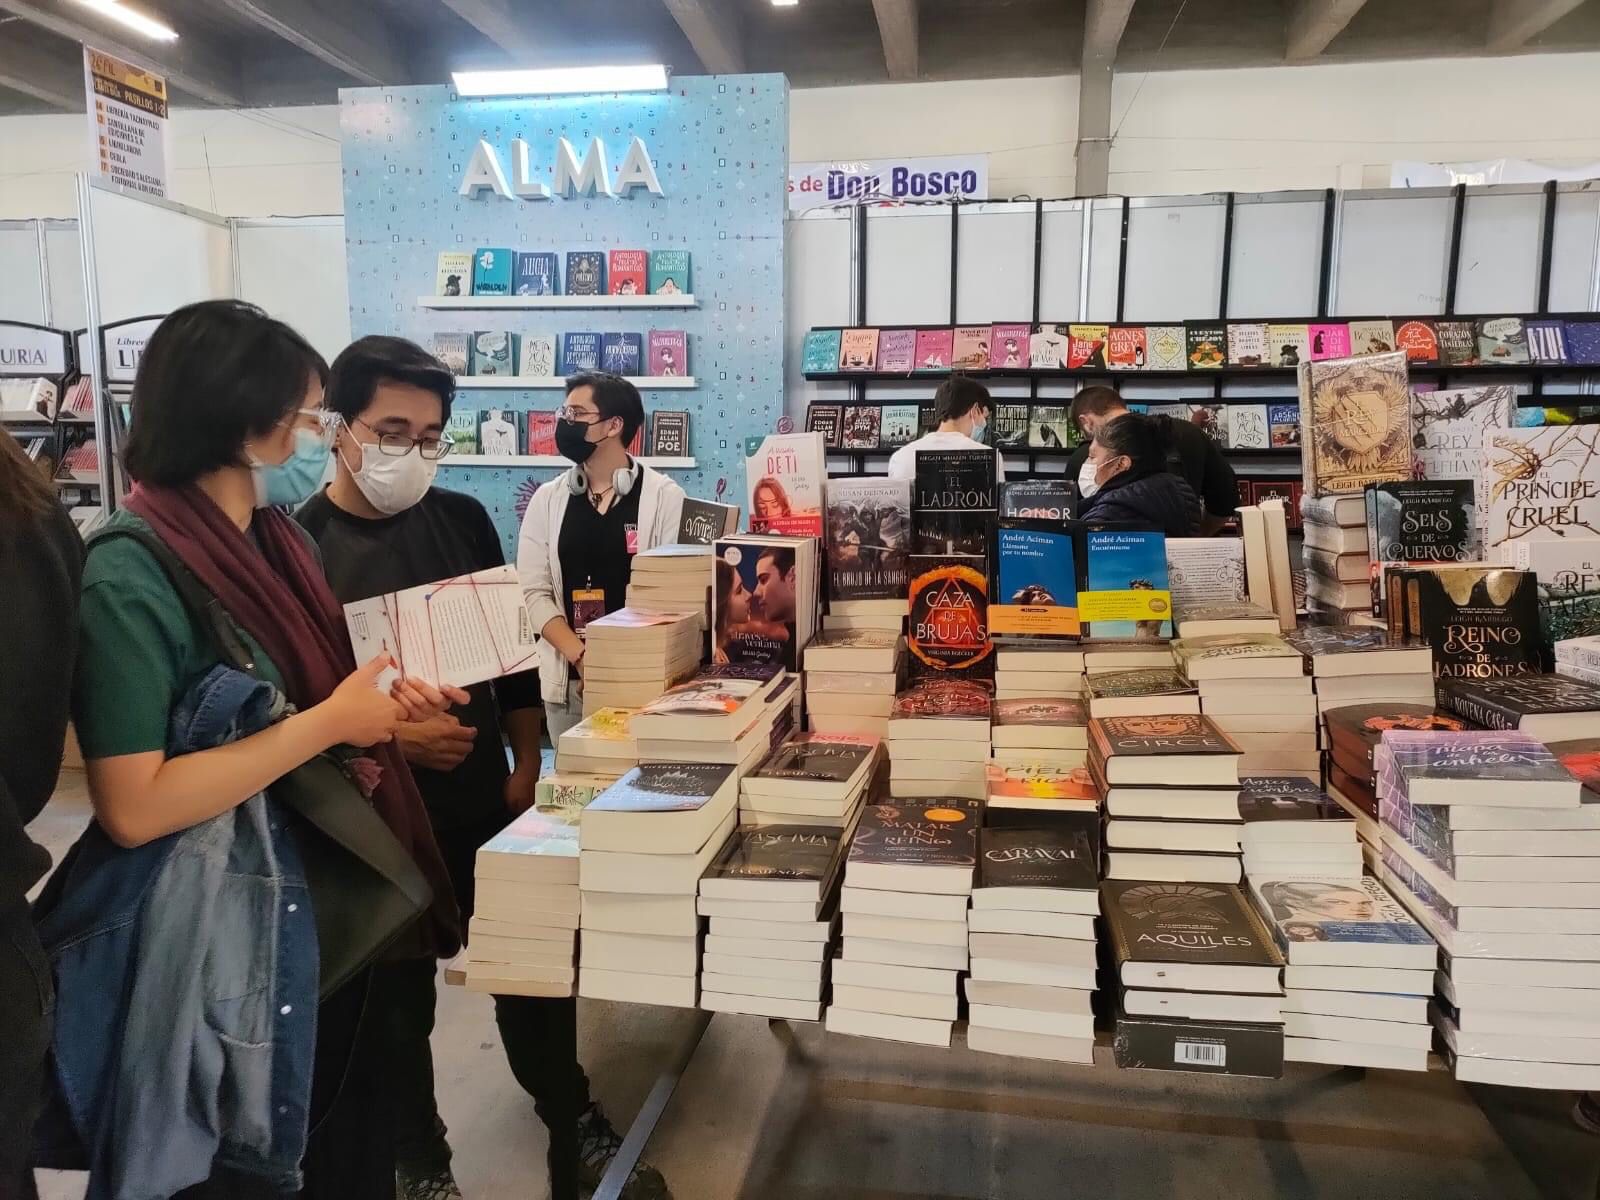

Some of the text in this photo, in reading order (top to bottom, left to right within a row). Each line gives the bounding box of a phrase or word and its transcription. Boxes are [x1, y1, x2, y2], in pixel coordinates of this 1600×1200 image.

[459, 136, 663, 202] ALMA
[799, 175, 823, 192] de
[828, 169, 880, 200] Don
[892, 166, 977, 197] Bosco
[1110, 330, 1144, 342] AGNES
[1439, 330, 1471, 339] CORAZÓN
[1072, 338, 1093, 349] Jane
[1110, 341, 1139, 353] GREY
[1526, 327, 1567, 360] AZUL
[996, 407, 1007, 418] LOS
[1007, 407, 1027, 419] MITOS
[657, 441, 681, 451] POE
[1429, 431, 1472, 455] REY
[1425, 459, 1483, 474] ELFHAM
[950, 476, 961, 487] EL
[1332, 481, 1356, 489] LEIGH
[920, 487, 993, 508] LADRÓN
[1007, 507, 1071, 520] HONOR
[1507, 505, 1590, 528] CRUEL
[1402, 509, 1452, 533] SEIS
[1002, 534, 1054, 544] André Aciman
[1091, 535, 1114, 543] André
[1421, 533, 1436, 543] DE
[1002, 542, 1029, 550] Llámame
[1386, 541, 1472, 563] CUERVOS
[1582, 562, 1593, 570] EL
[842, 571, 863, 587] BRUJO
[864, 571, 872, 586] DE
[874, 570, 882, 585] LA
[883, 569, 908, 585] SANGRE
[925, 591, 975, 609] CAZA
[944, 611, 955, 621] DE
[916, 623, 987, 642] BRUJAS
[1442, 624, 1521, 654] REINO
[1476, 653, 1491, 663] DE
[1433, 661, 1529, 679] LADRONES
[1454, 696, 1485, 726] NOVENA
[1485, 709, 1506, 730] CASA
[1117, 738, 1221, 747] CIRCE
[880, 821, 953, 831] MATAR
[902, 829, 935, 837] UN
[884, 836, 952, 845] REINO
[985, 847, 1080, 862] CARAVAL
[1137, 933, 1252, 949] AQUILES
